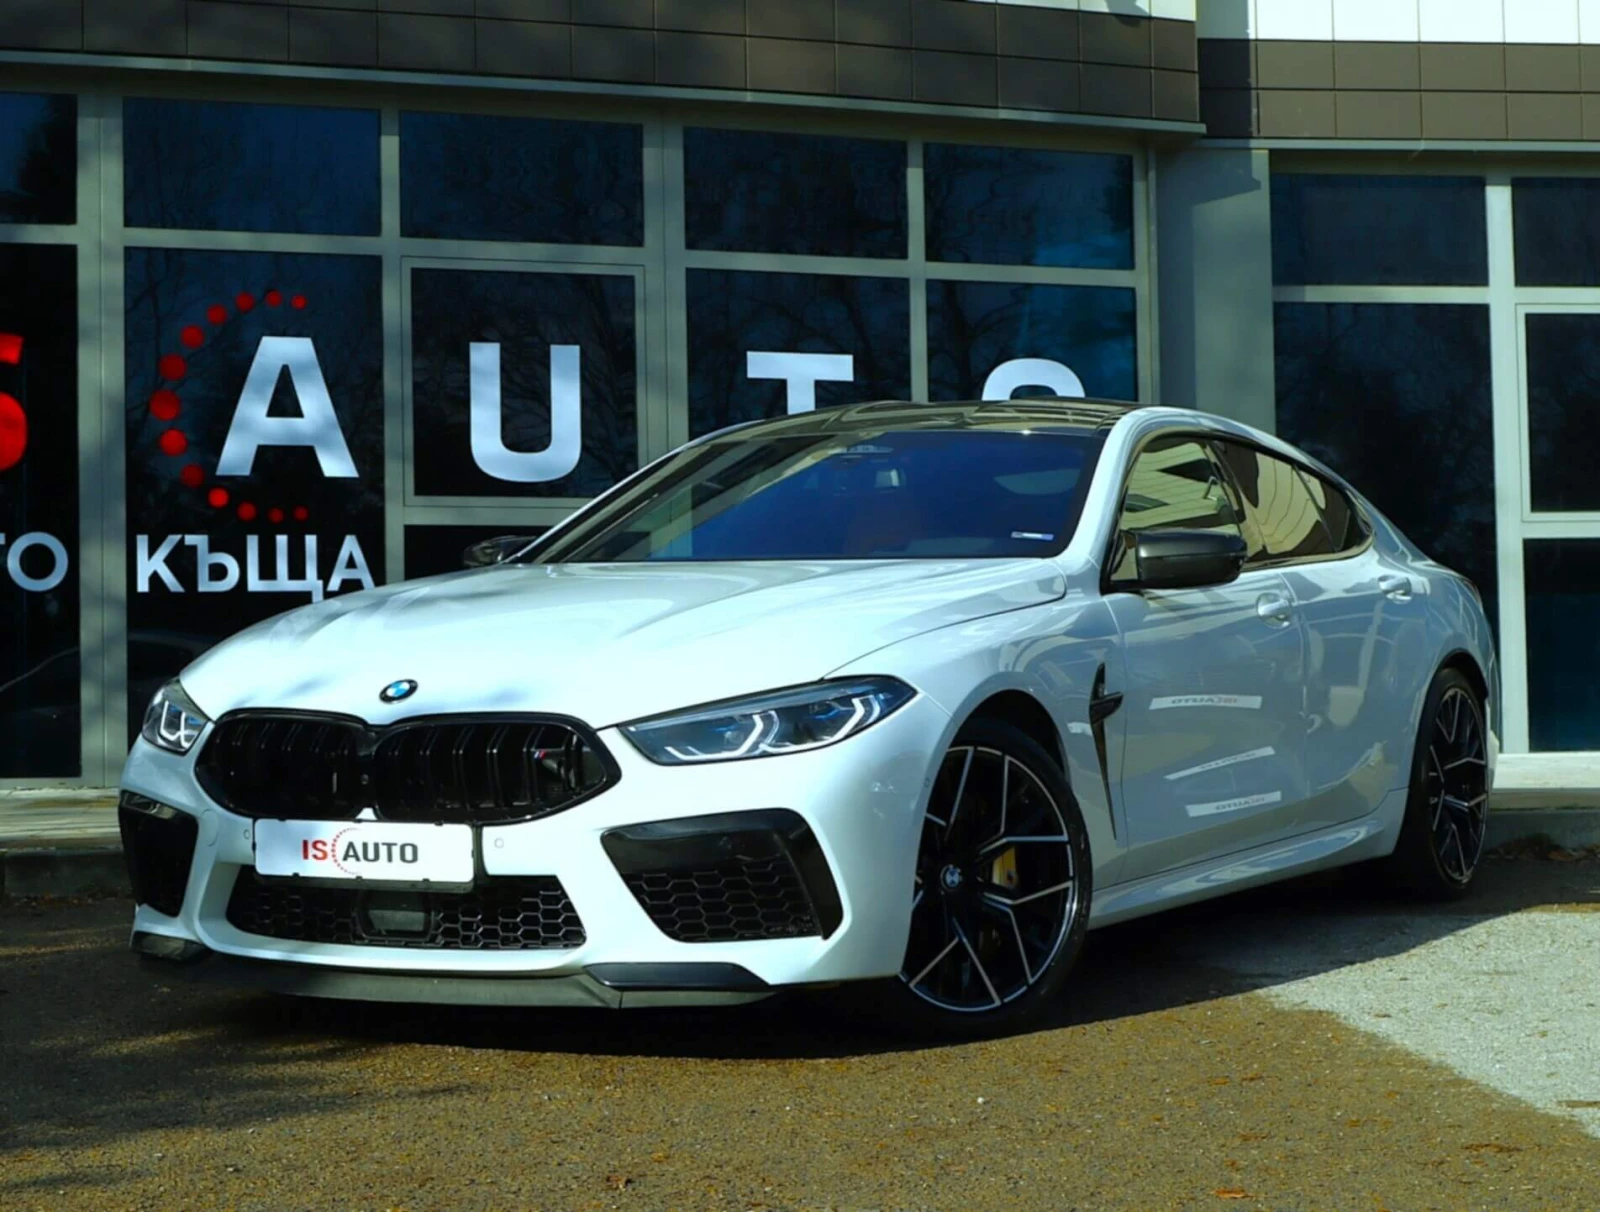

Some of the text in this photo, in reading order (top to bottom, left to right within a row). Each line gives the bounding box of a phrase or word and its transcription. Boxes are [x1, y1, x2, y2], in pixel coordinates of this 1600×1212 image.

[215, 336, 1086, 482] AUT
[136, 534, 376, 604] КЪЩА
[302, 839, 419, 864] IS AUTO
